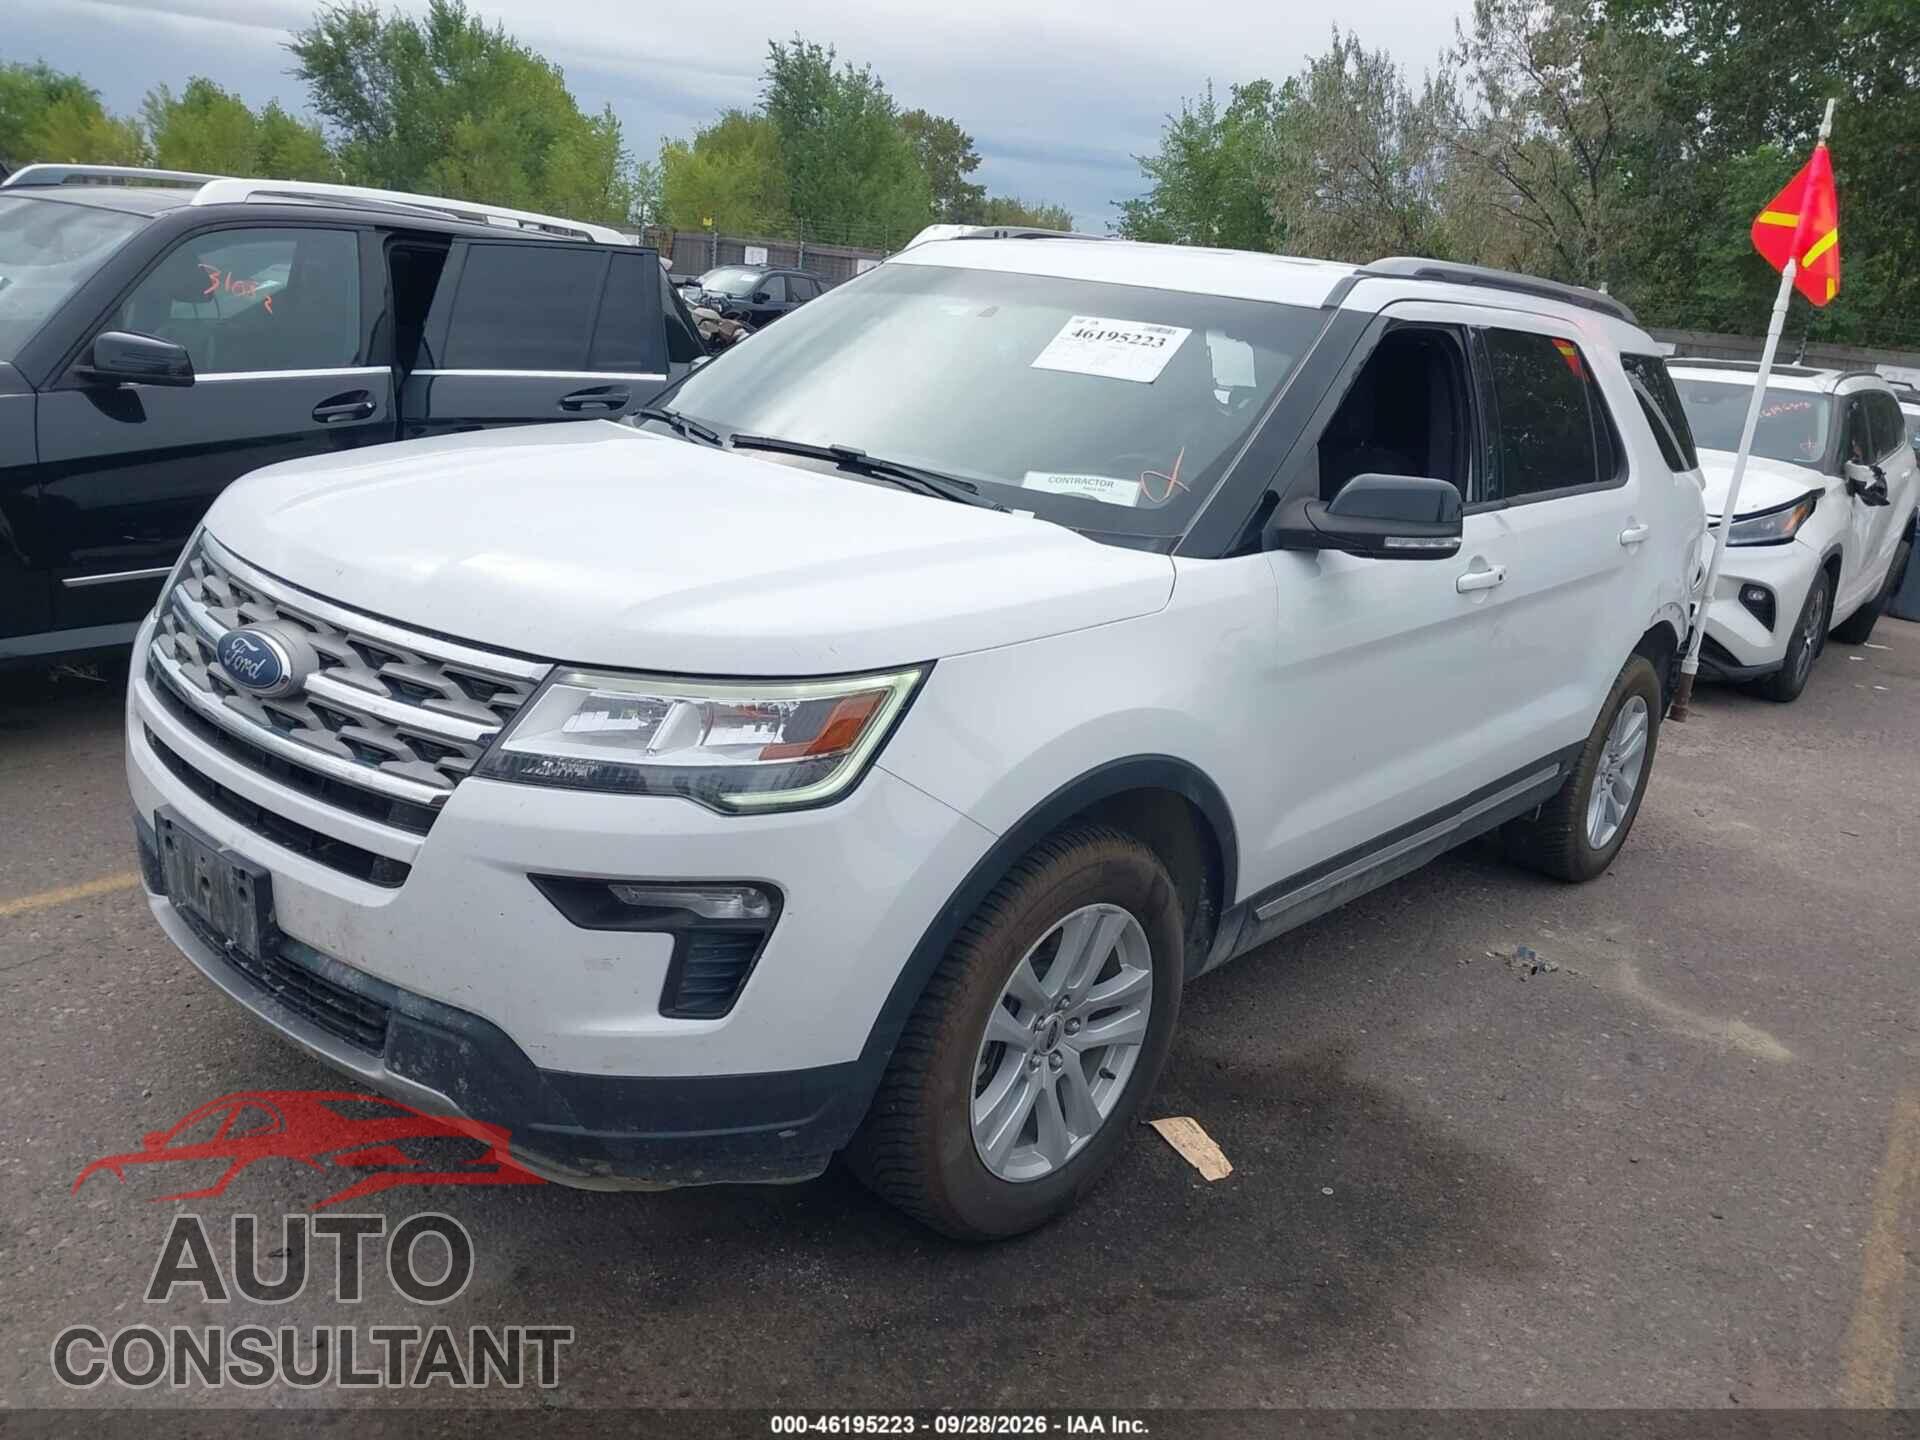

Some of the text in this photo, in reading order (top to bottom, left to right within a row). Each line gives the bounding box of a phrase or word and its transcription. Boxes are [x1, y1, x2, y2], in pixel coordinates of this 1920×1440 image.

[1071, 327, 1167, 348] 46195223
[1047, 475, 1115, 488] CONTRACTOR
[224, 637, 267, 680] Ford
